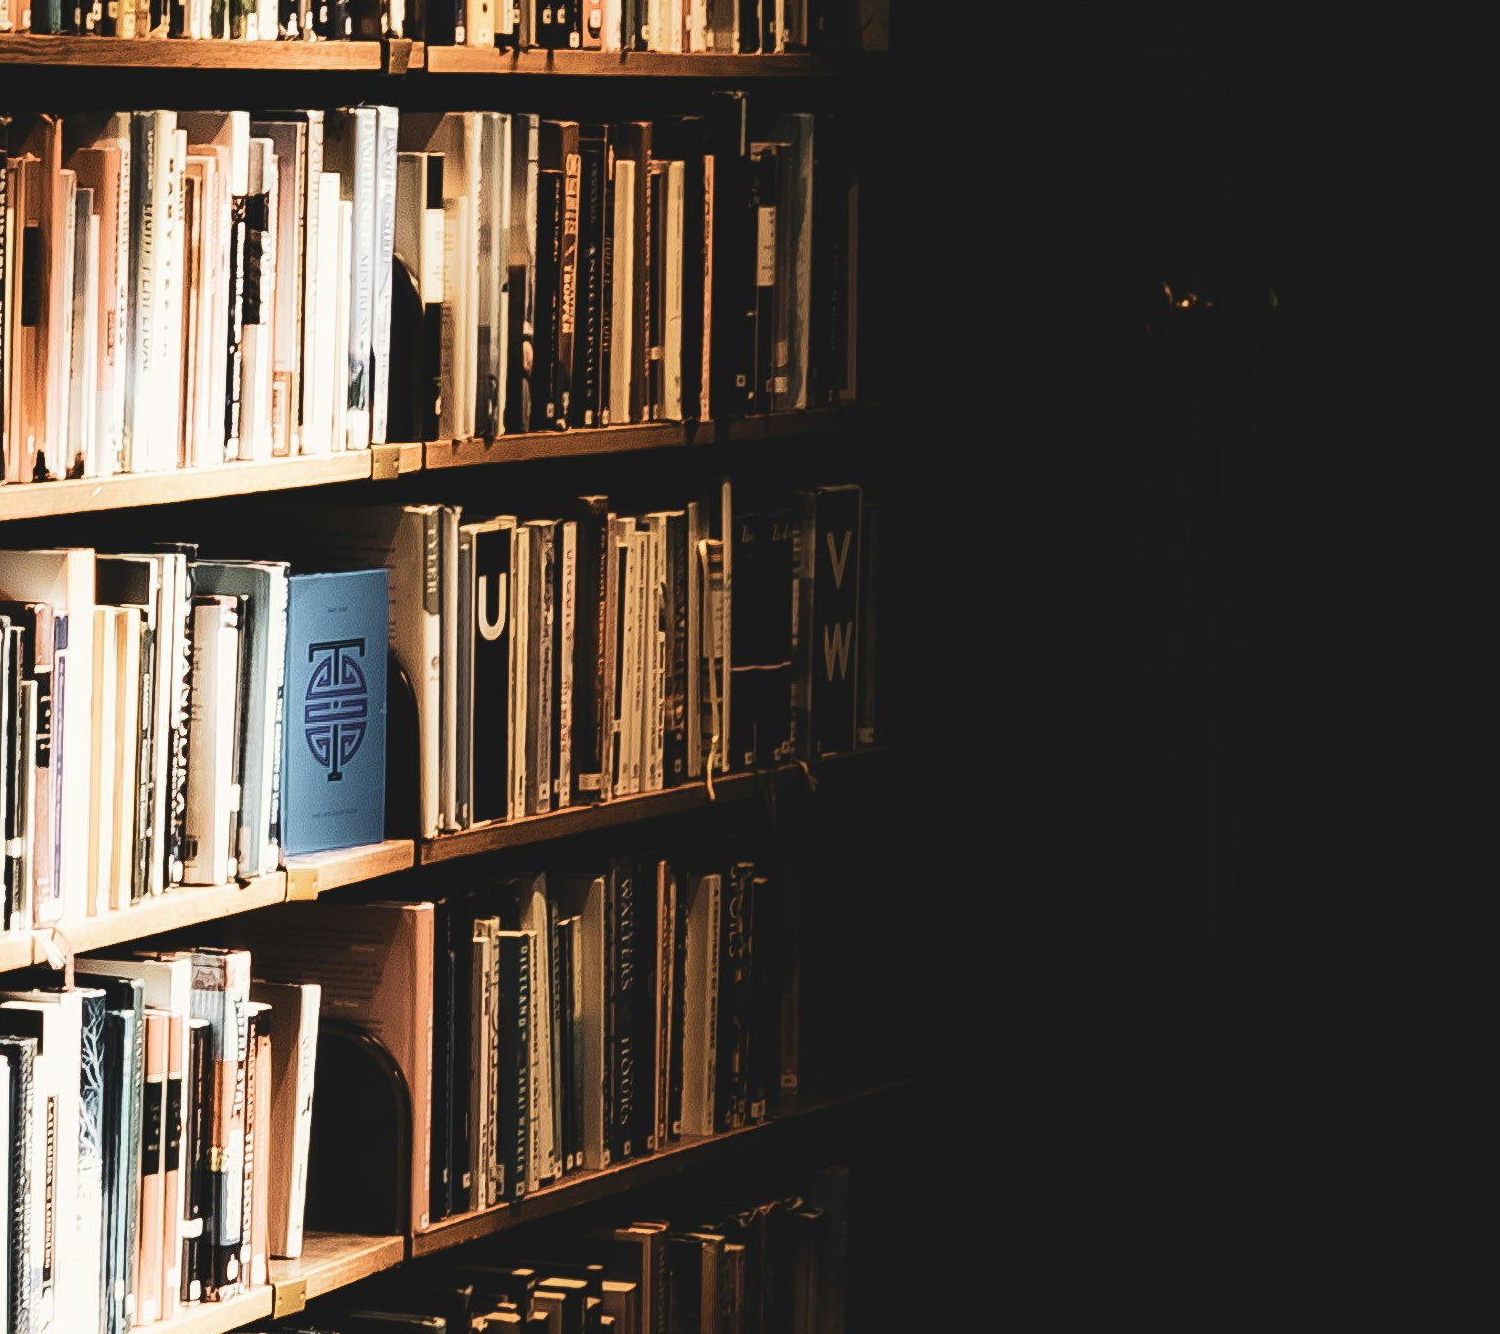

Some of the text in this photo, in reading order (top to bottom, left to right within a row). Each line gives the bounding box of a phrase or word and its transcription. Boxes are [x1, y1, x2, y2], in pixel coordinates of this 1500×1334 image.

[586, 243, 596, 398] ANGELOPOLIS
[826, 529, 853, 591] V
[478, 571, 507, 642] U
[823, 621, 853, 684] W
[518, 944, 528, 1029] DIETLAND
[516, 1115, 526, 1174] WALKER
